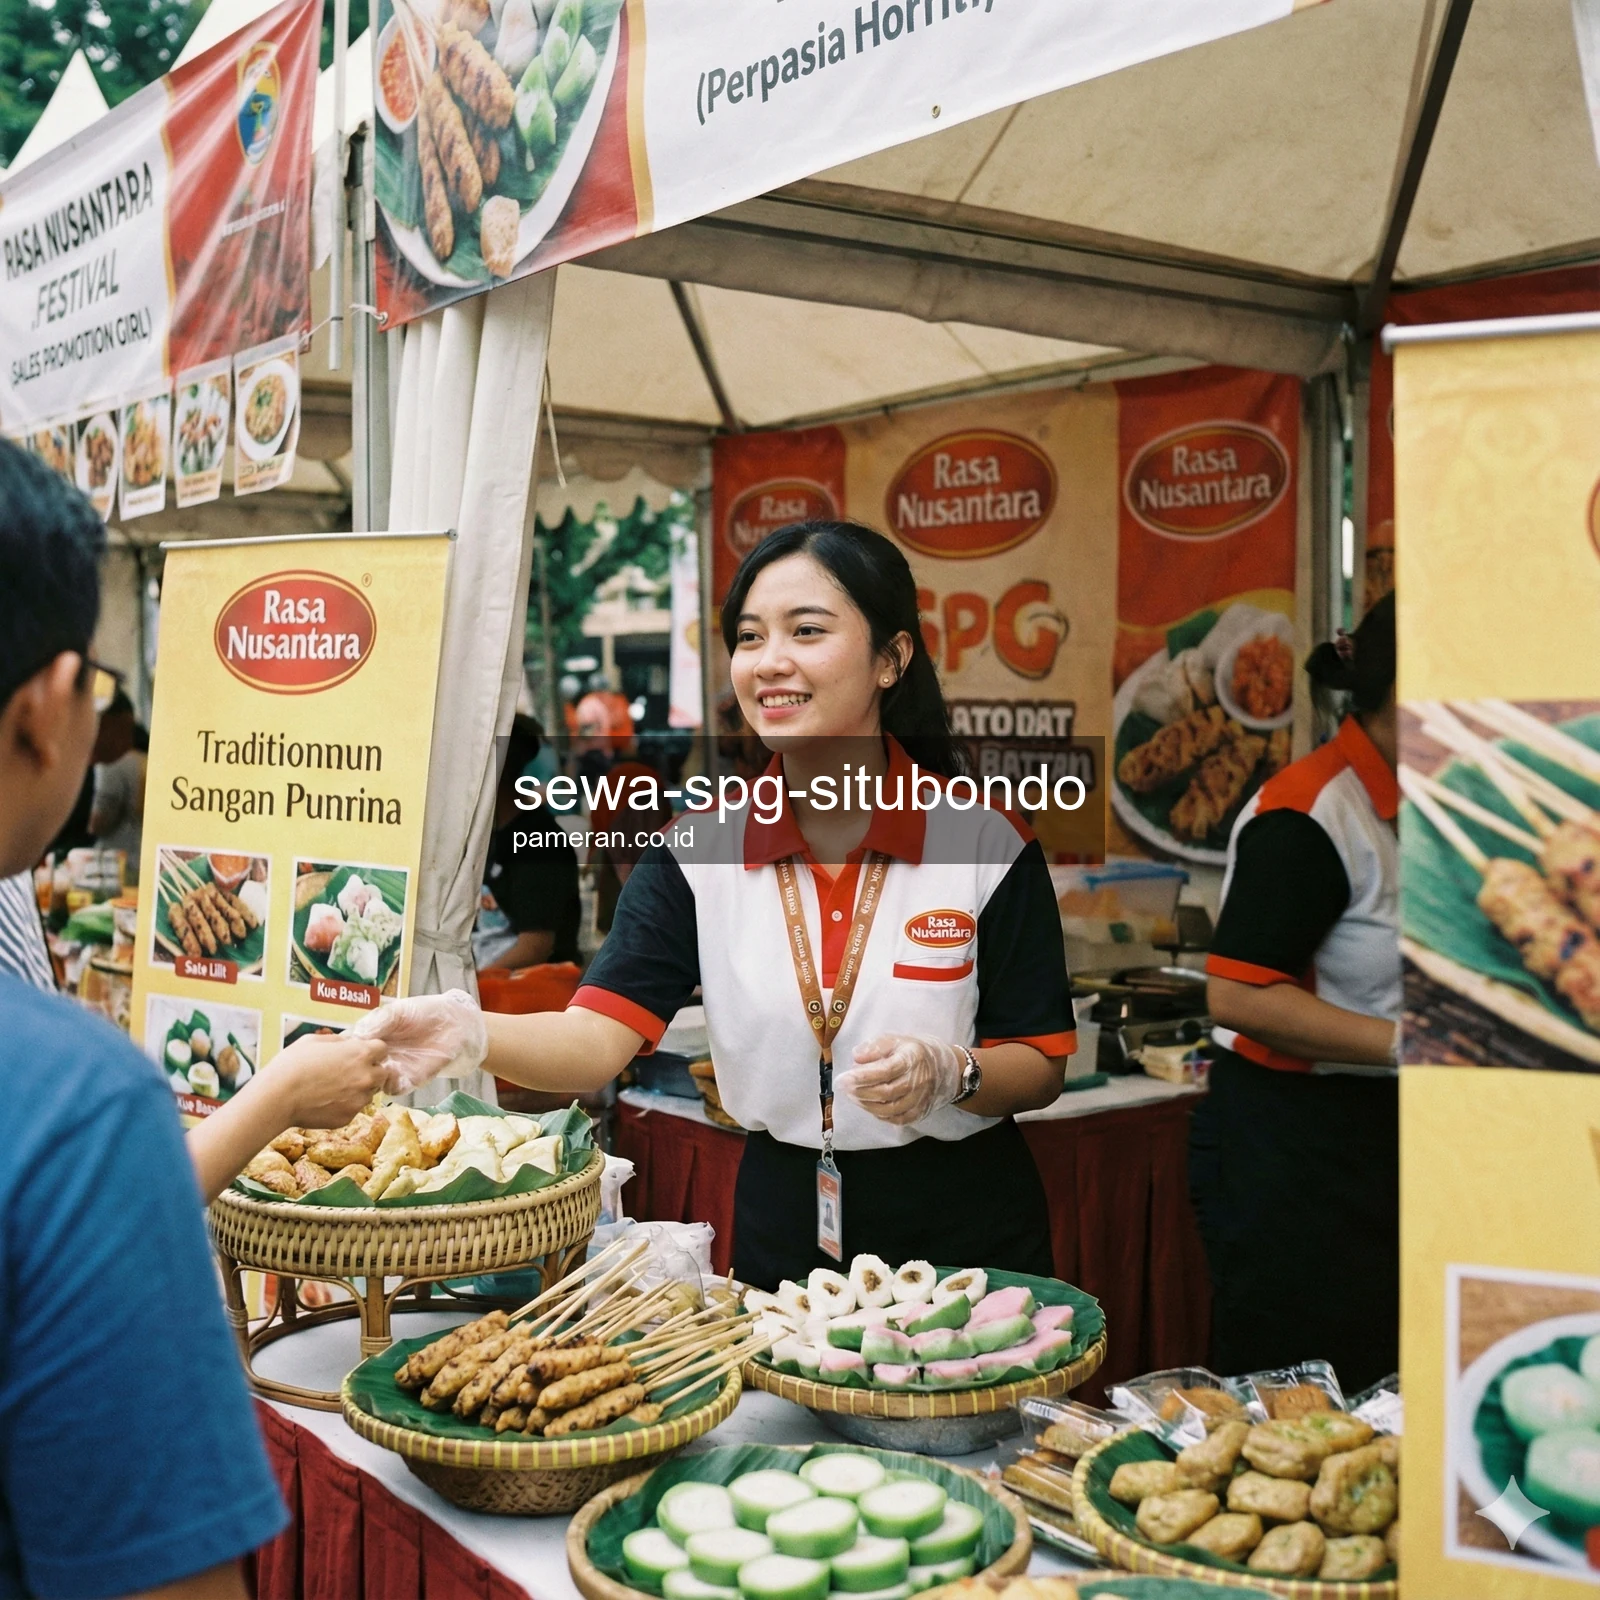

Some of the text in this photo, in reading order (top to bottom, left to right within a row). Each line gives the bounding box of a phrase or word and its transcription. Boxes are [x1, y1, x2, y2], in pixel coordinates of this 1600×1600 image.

[697, 21, 846, 126] (Perpasia
[4, 223, 46, 281] RASA
[45, 161, 153, 261] NUSANTARA
[43, 321, 115, 374] PROMOTION
[116, 306, 152, 344] GIRL)
[934, 453, 1001, 490] Rasa
[1172, 445, 1238, 477] Rasa
[898, 487, 1042, 529] Nusantara
[1139, 473, 1272, 511] Nusantara
[263, 589, 326, 625] Rasa
[227, 625, 360, 660] Nusantara
[197, 730, 382, 771] Traditionnun
[170, 776, 401, 825] Sangan Punrina
[927, 916, 957, 929] Rasa
[317, 981, 370, 1005] Kue Basah
